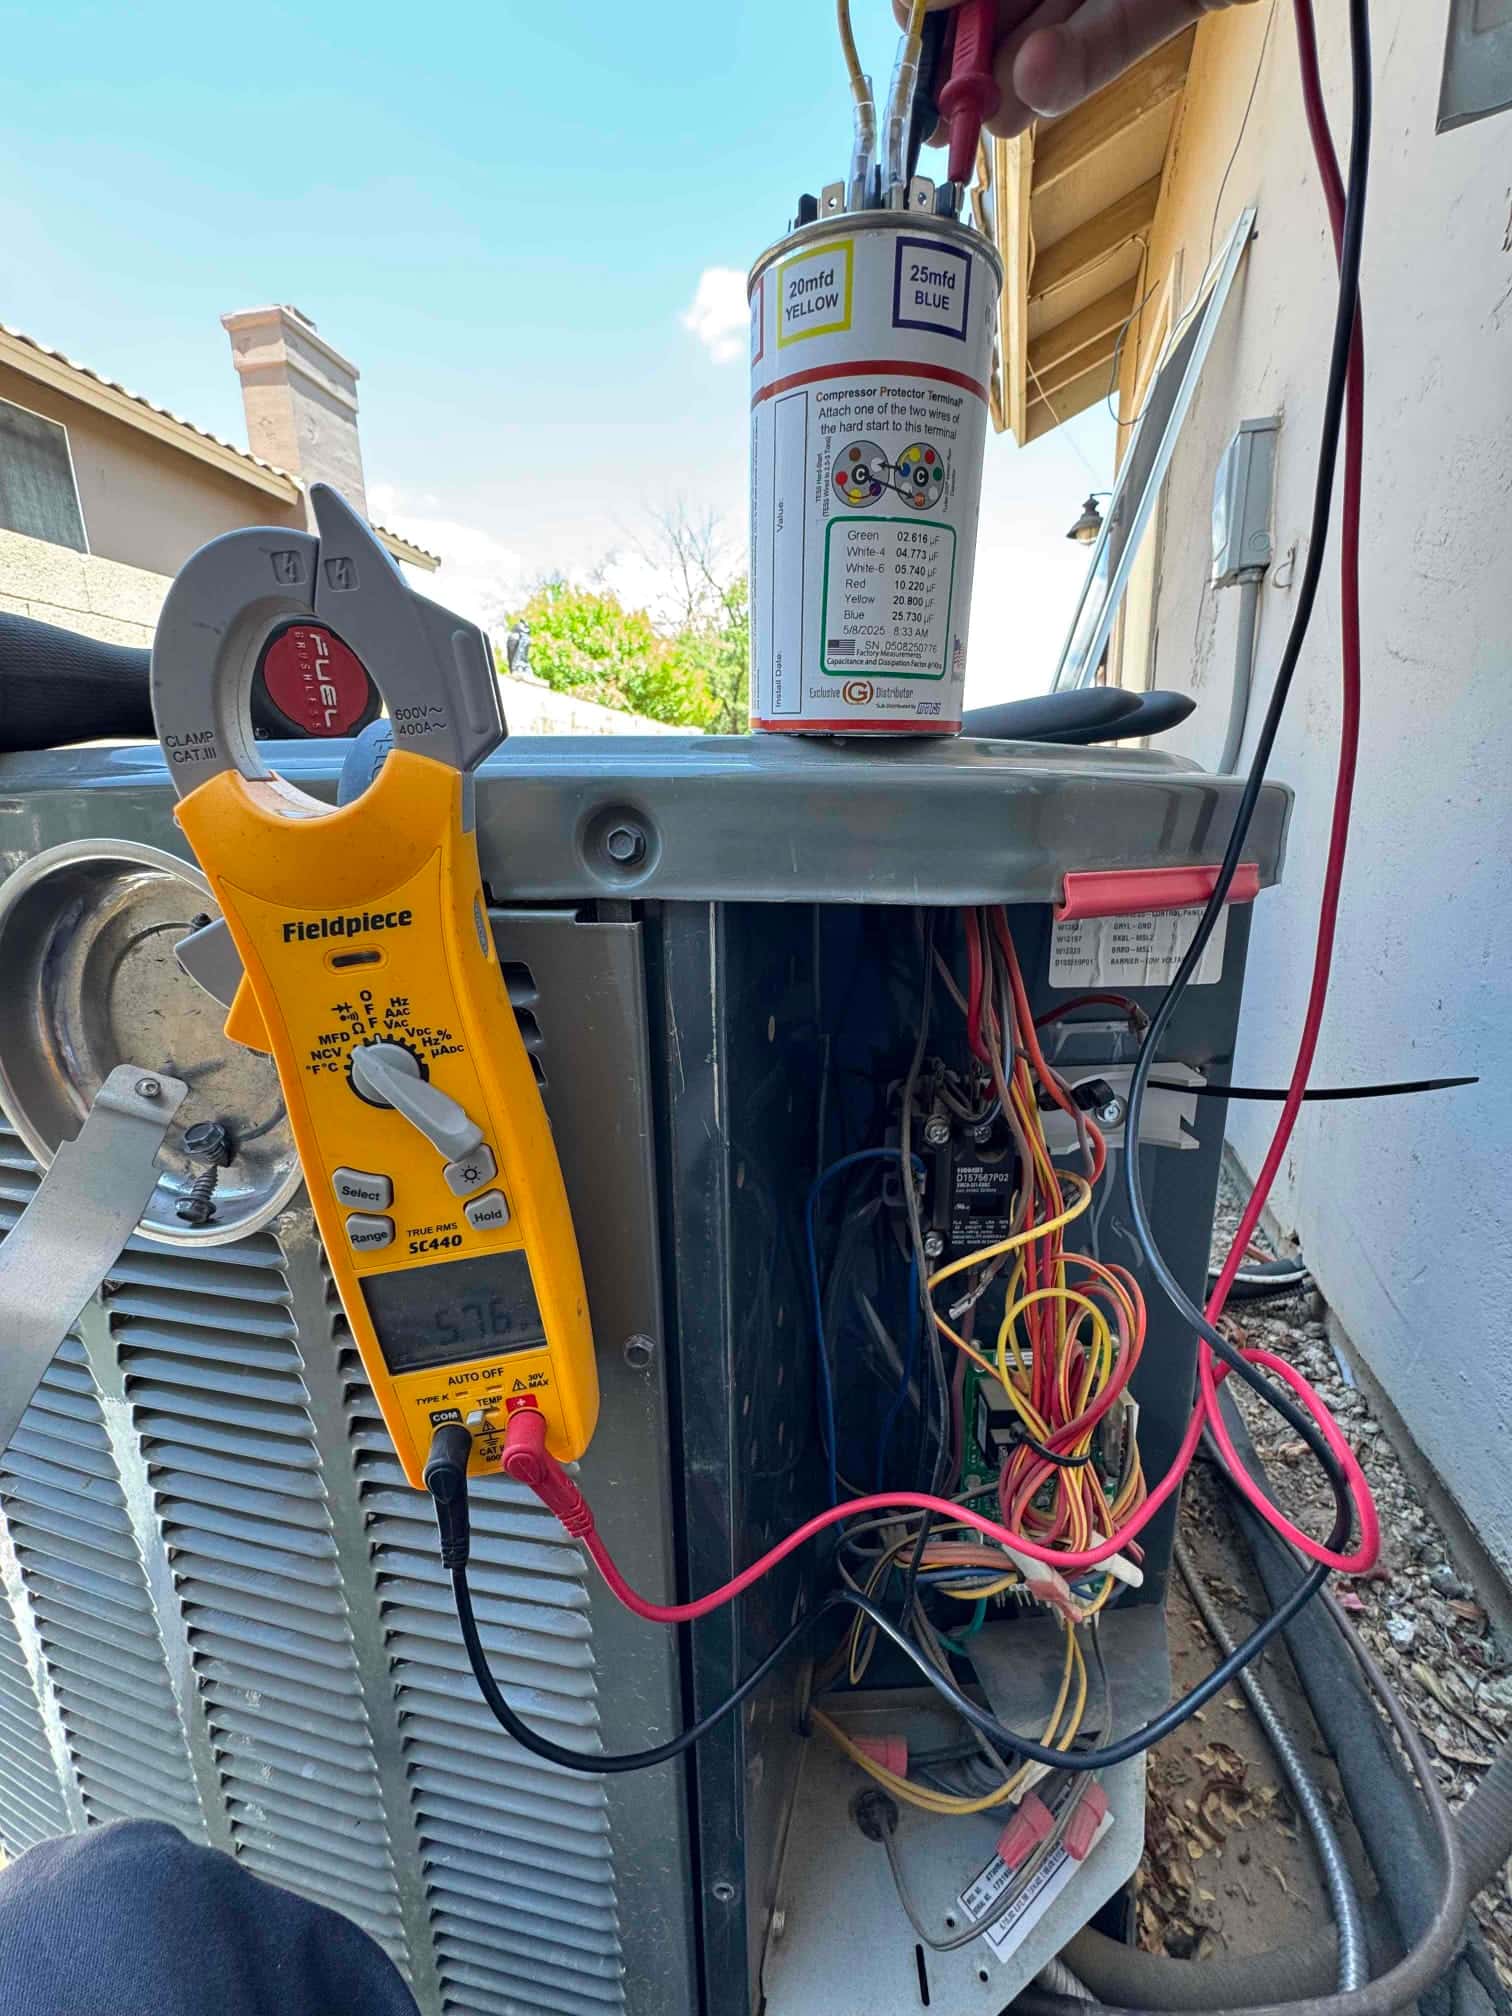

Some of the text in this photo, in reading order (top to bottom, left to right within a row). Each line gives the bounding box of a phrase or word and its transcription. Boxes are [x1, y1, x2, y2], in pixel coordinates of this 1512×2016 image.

[788, 268, 834, 298] 20mfd
[910, 264, 956, 290] 25mfd
[785, 293, 839, 321] YELLOW
[914, 290, 950, 311] BLUE
[816, 387, 877, 402] Compressor
[880, 386, 926, 399] Protector
[818, 402, 960, 424] Attach one of the two wires of
[821, 420, 958, 440] the hard start to this terminal
[848, 530, 879, 540] Green
[847, 546, 886, 558] White-4
[896, 548, 926, 560] 04.773
[895, 564, 926, 576] 05.740
[846, 579, 866, 588] Red
[895, 580, 924, 592] 10.220
[845, 594, 876, 604] Yellow
[844, 610, 864, 620] Blue
[892, 611, 922, 622] 25.730
[843, 625, 886, 636] 5/8/2025
[914, 628, 928, 638] AM
[856, 649, 922, 659] Factory Measurements
[826, 658, 864, 666] Capacitance
[865, 658, 877, 666] and
[309, 632, 338, 728] FUEL
[810, 688, 840, 699] Exclusive
[876, 688, 914, 699] Distributor
[165, 731, 215, 748] CLAMP
[282, 910, 412, 943] Fieldpiece
[390, 996, 409, 1008] Hz
[318, 1031, 350, 1046] MFD
[310, 1048, 342, 1061] NCV
[341, 1186, 381, 1201] Select
[474, 1209, 503, 1222] Hold
[406, 1222, 458, 1238] TRUE RMS
[350, 1230, 388, 1245] Range
[409, 1234, 462, 1254] SC440
[448, 1367, 504, 1386] AUTO OFF
[528, 1380, 550, 1388] MAX
[416, 1395, 440, 1406] TYPE
[476, 1395, 502, 1406] TEMP
[432, 1411, 459, 1422] COM
